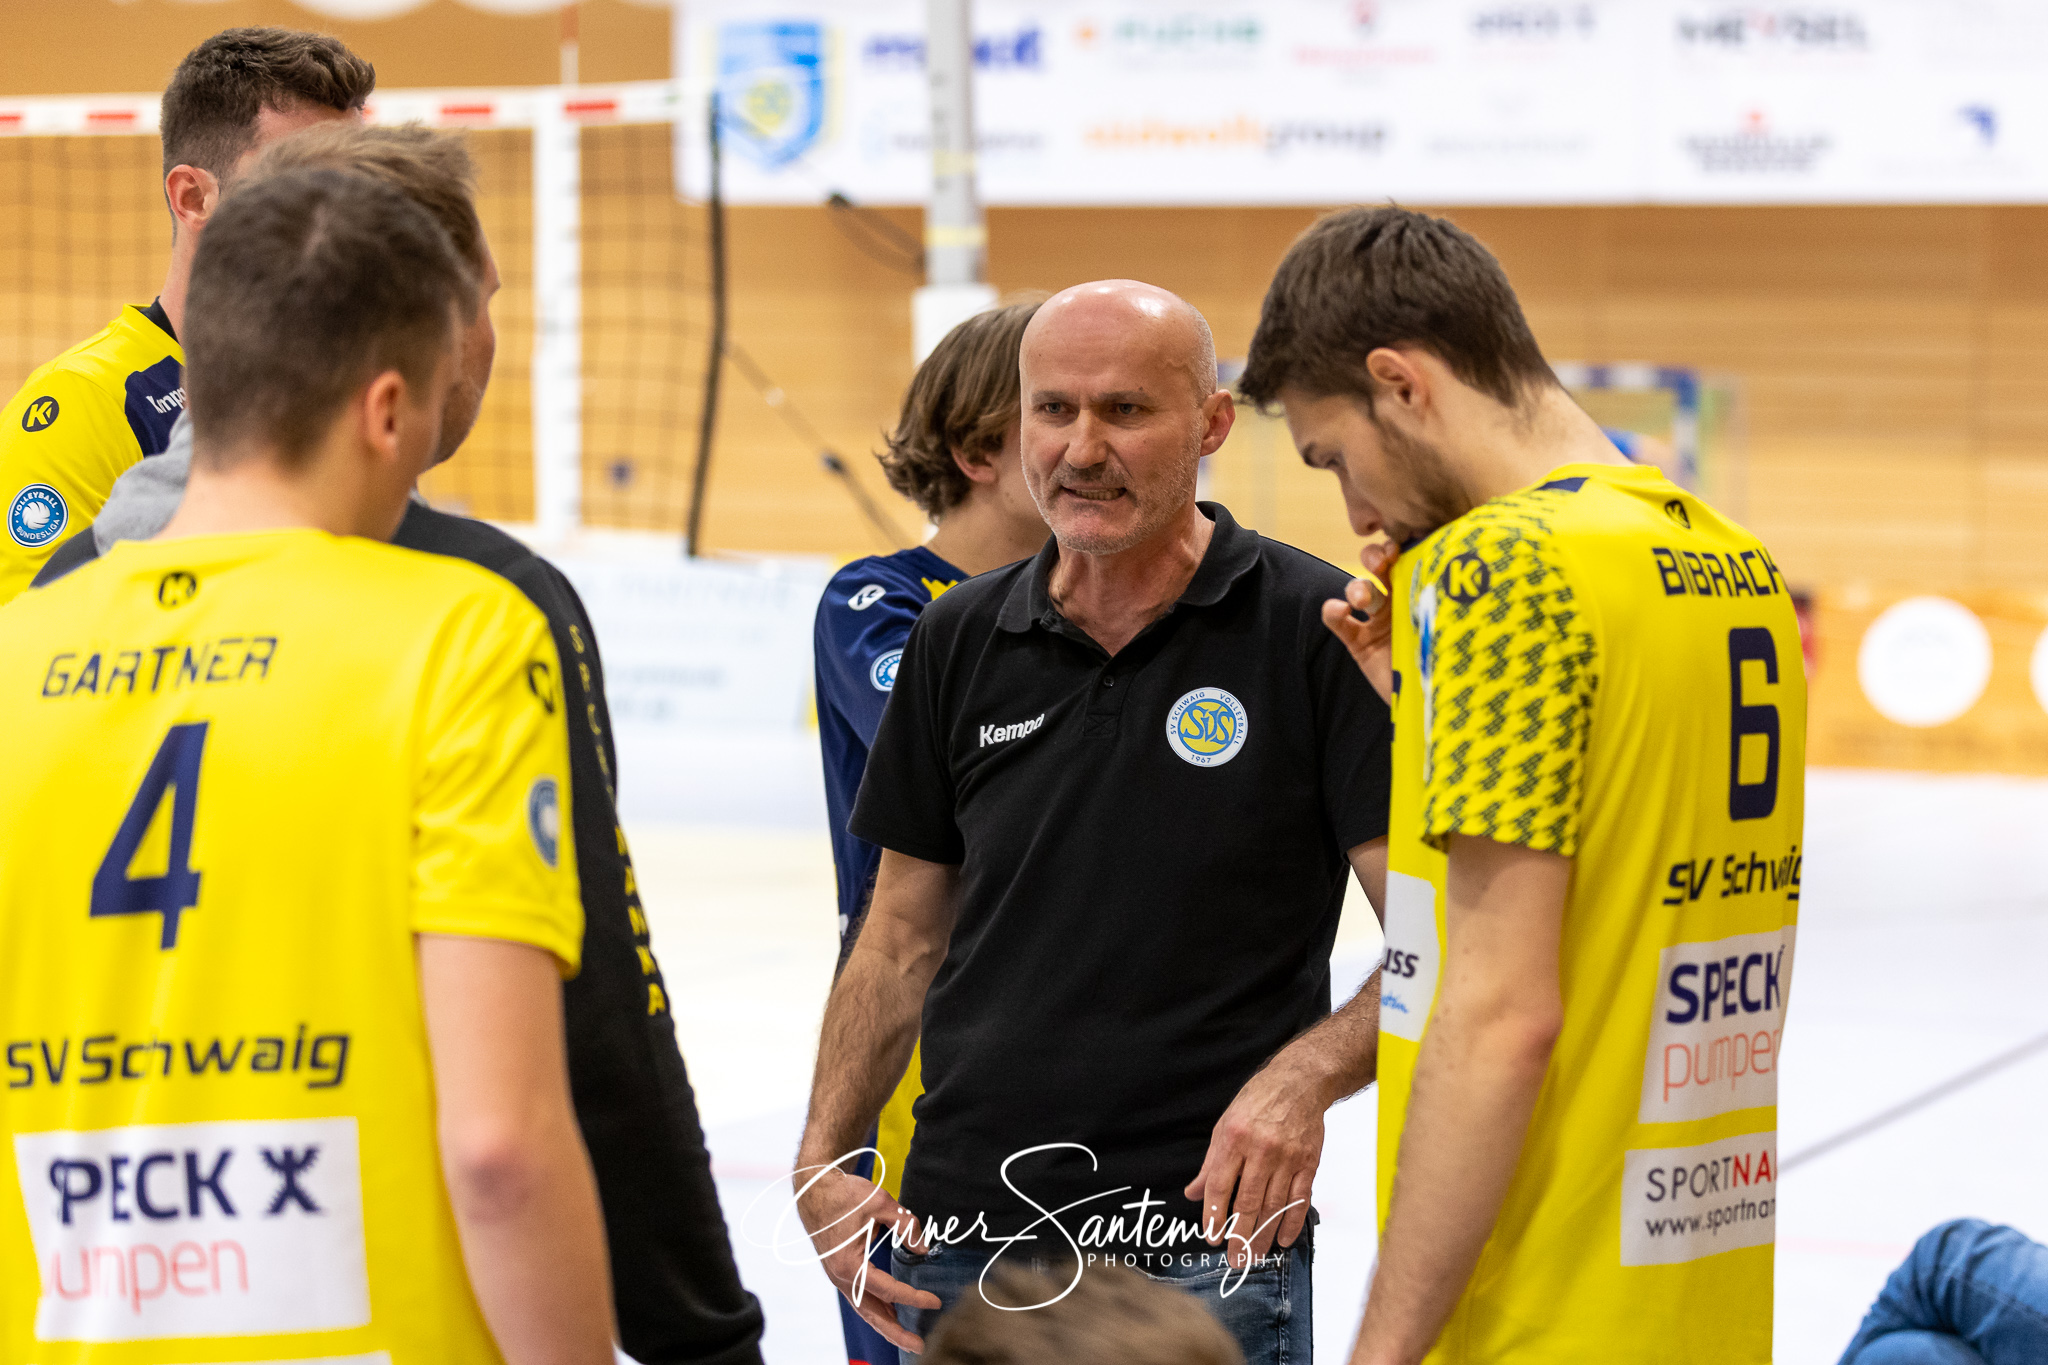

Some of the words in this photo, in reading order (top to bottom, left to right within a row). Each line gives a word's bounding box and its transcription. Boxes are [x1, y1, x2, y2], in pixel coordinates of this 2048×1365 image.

[14, 491, 58, 509] VOLLEYBALL
[16, 519, 61, 540] BUNDESLIGA
[42, 636, 278, 697] GARTNER
[1171, 691, 1206, 721] SCHWAIG
[1220, 693, 1245, 745] VOLLEYBALL
[1728, 626, 1780, 821] 6
[1190, 754, 1212, 764] 1967
[89, 720, 209, 951] 4
[1663, 858, 1714, 906] SV
[1666, 944, 1786, 1024] SPECK
[7, 1038, 69, 1090] SV
[79, 1021, 351, 1091] Schwaig
[1646, 1150, 1777, 1203] SPORTNA
